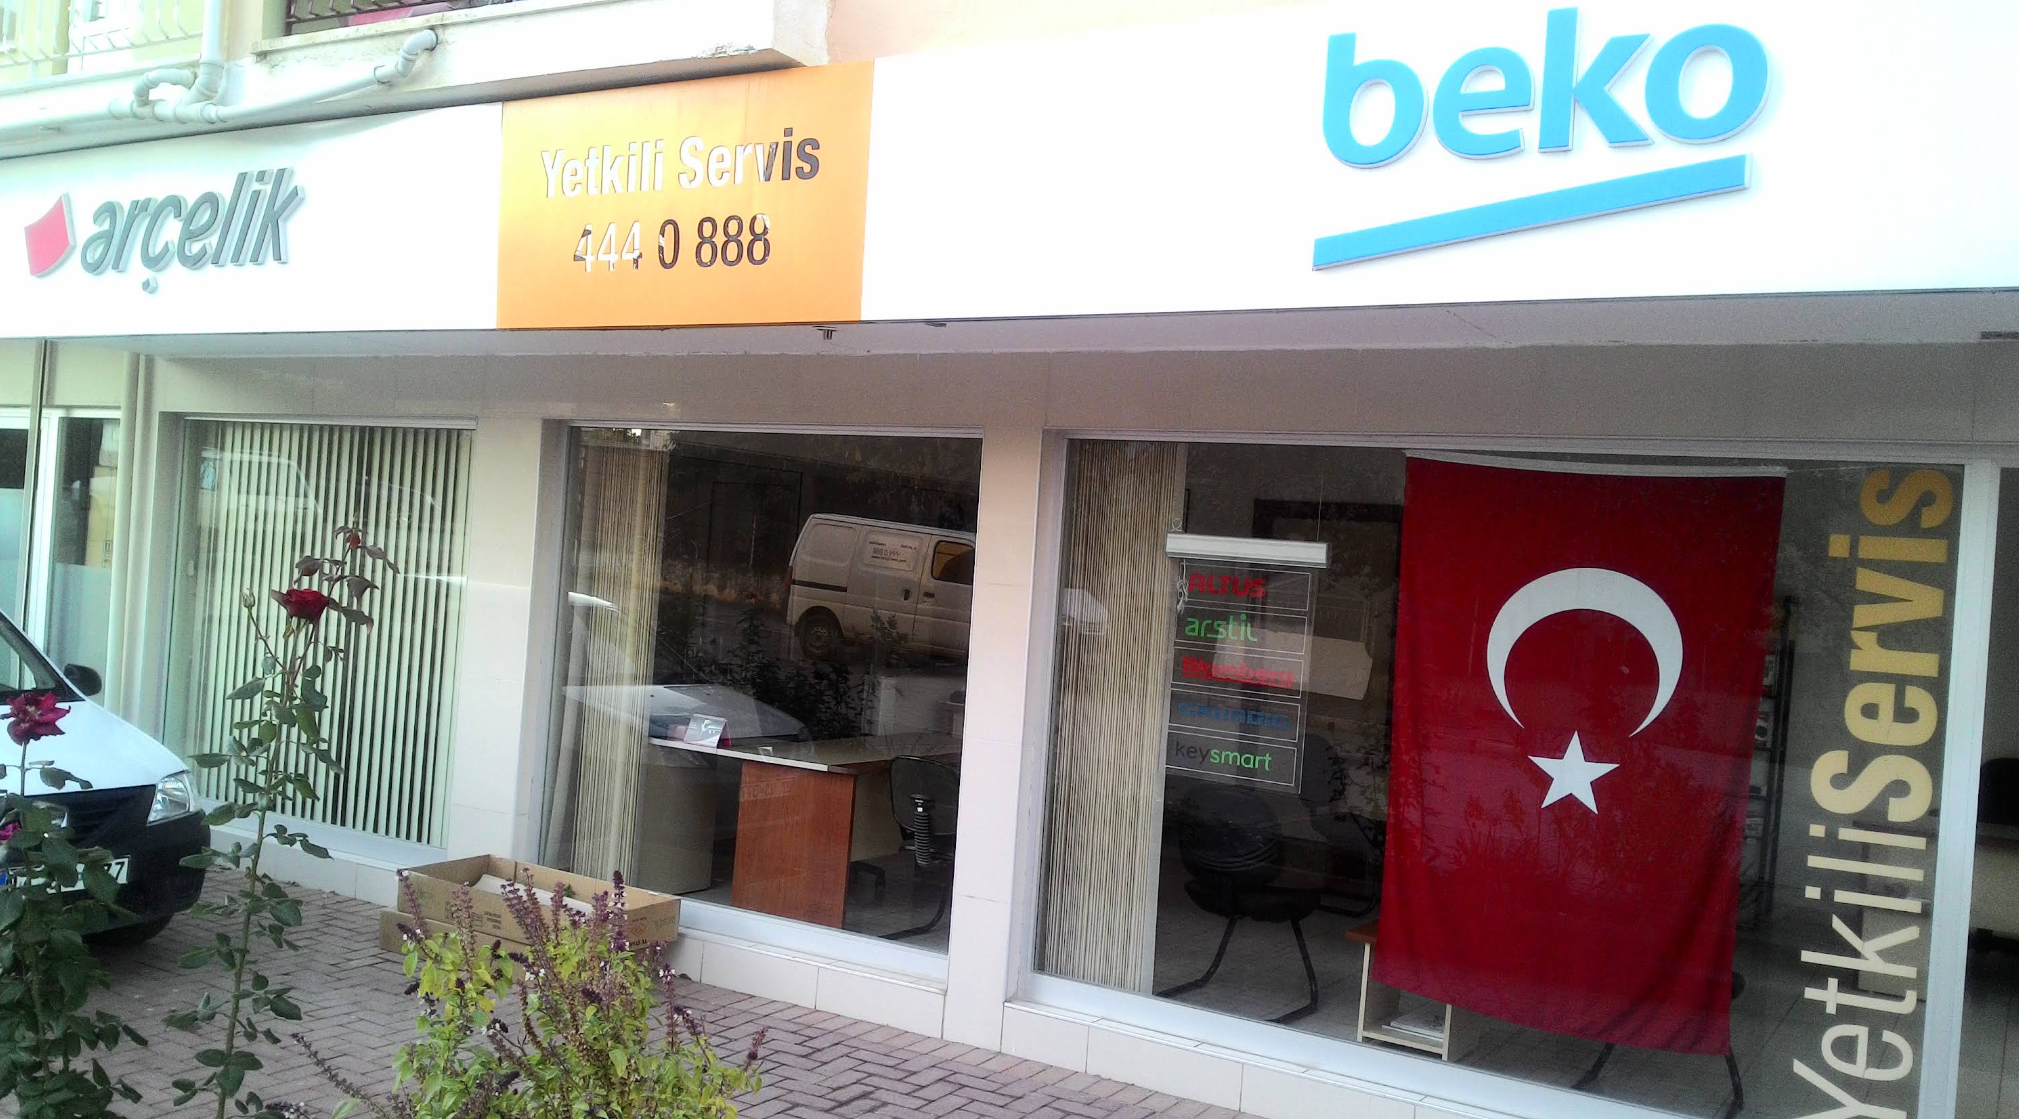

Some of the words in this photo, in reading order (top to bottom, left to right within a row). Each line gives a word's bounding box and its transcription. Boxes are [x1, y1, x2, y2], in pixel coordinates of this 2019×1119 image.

[1322, 7, 1770, 168] beko
[541, 139, 664, 198] Yetkili
[678, 127, 820, 189] Servis
[81, 167, 306, 294] arçelik
[574, 220, 642, 272] 444
[658, 219, 680, 269] 0
[695, 213, 770, 268] 888
[1187, 572, 1268, 598] ALTUS
[1184, 613, 1258, 641] arstil
